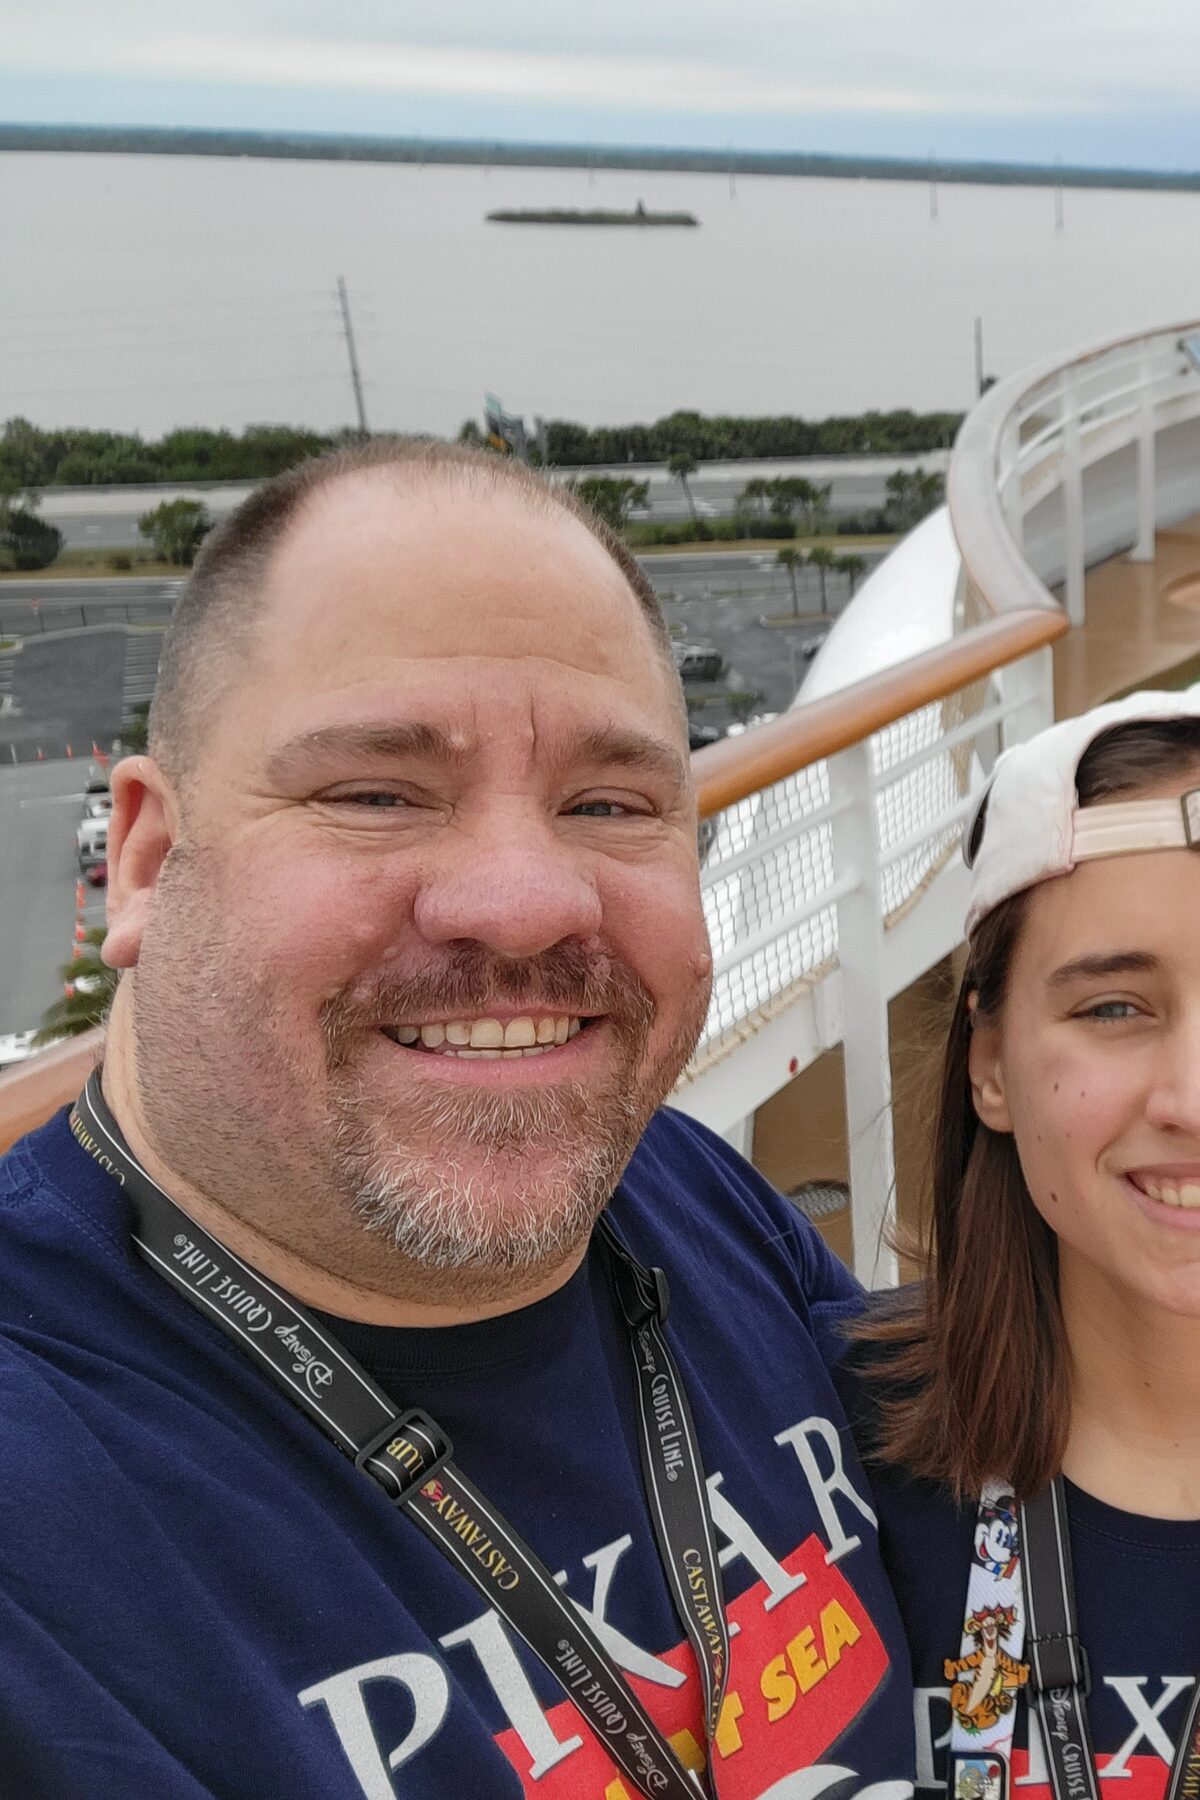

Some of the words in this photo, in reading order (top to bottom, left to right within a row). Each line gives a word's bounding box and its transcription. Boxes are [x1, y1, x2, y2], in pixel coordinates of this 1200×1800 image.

[210, 1275, 273, 1332] CRUISE
[651, 1373, 676, 1432] CRUISE
[386, 1437, 425, 1480] LUB
[429, 1493, 521, 1591] CASTAWAY
[682, 1548, 724, 1659] CASTAWAY
[760, 1597, 862, 1723] SEA
[581, 1681, 628, 1735] CRUISE
[1061, 1743, 1087, 1796] CRUISE
